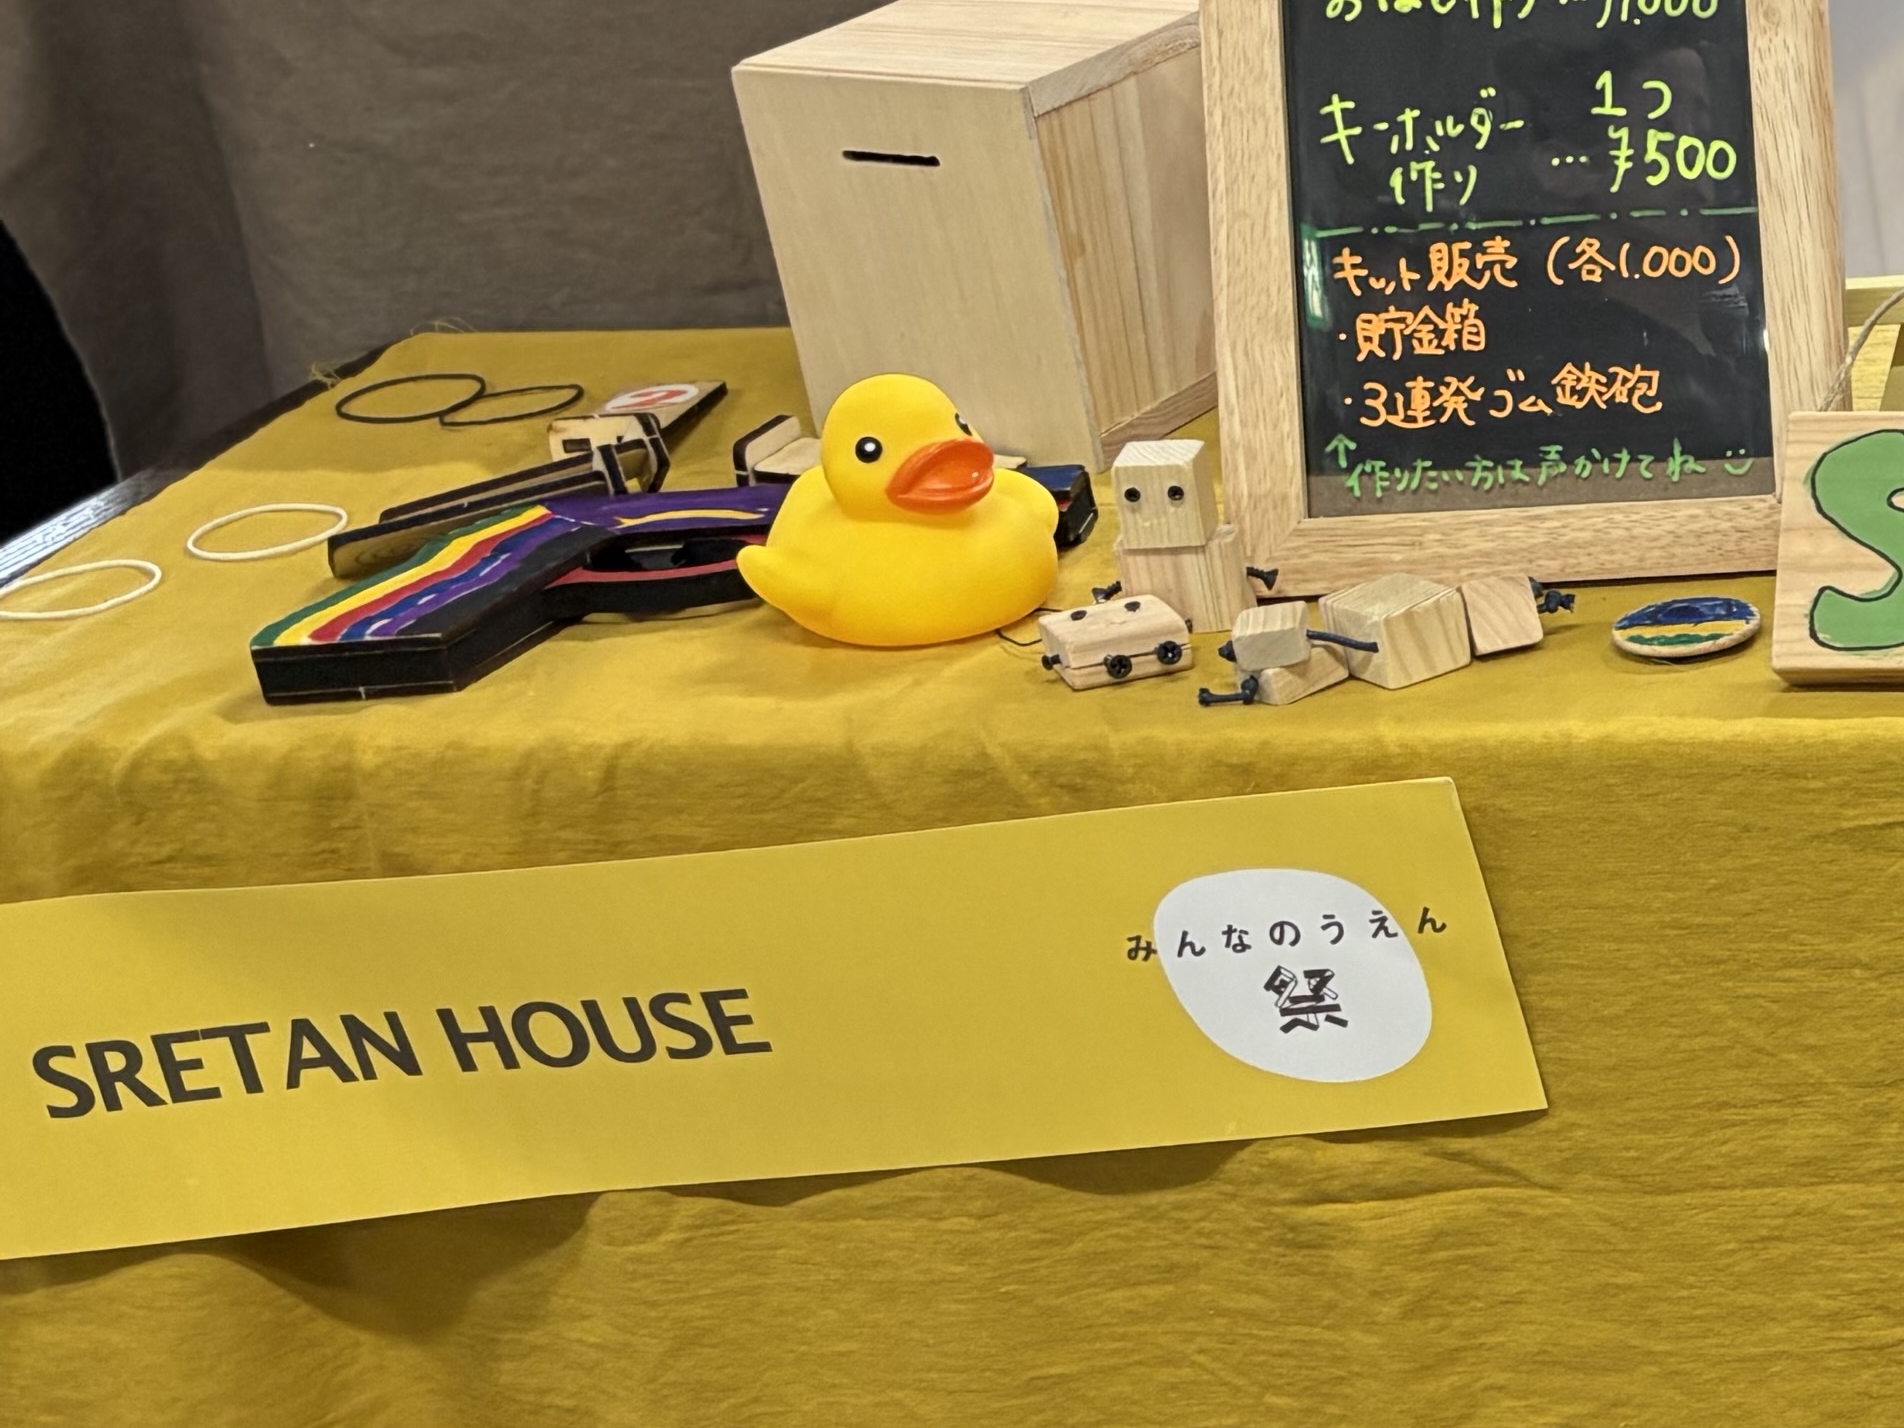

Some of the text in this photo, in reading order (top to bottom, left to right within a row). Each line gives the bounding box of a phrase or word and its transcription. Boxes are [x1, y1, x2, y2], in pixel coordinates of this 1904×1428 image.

[1390, 160, 1477, 212] 作り
[1332, 235, 1519, 296] キット販売
[1126, 906, 1448, 962] みんなのうえん
[30, 987, 772, 1121] SRETAN HOUSE
